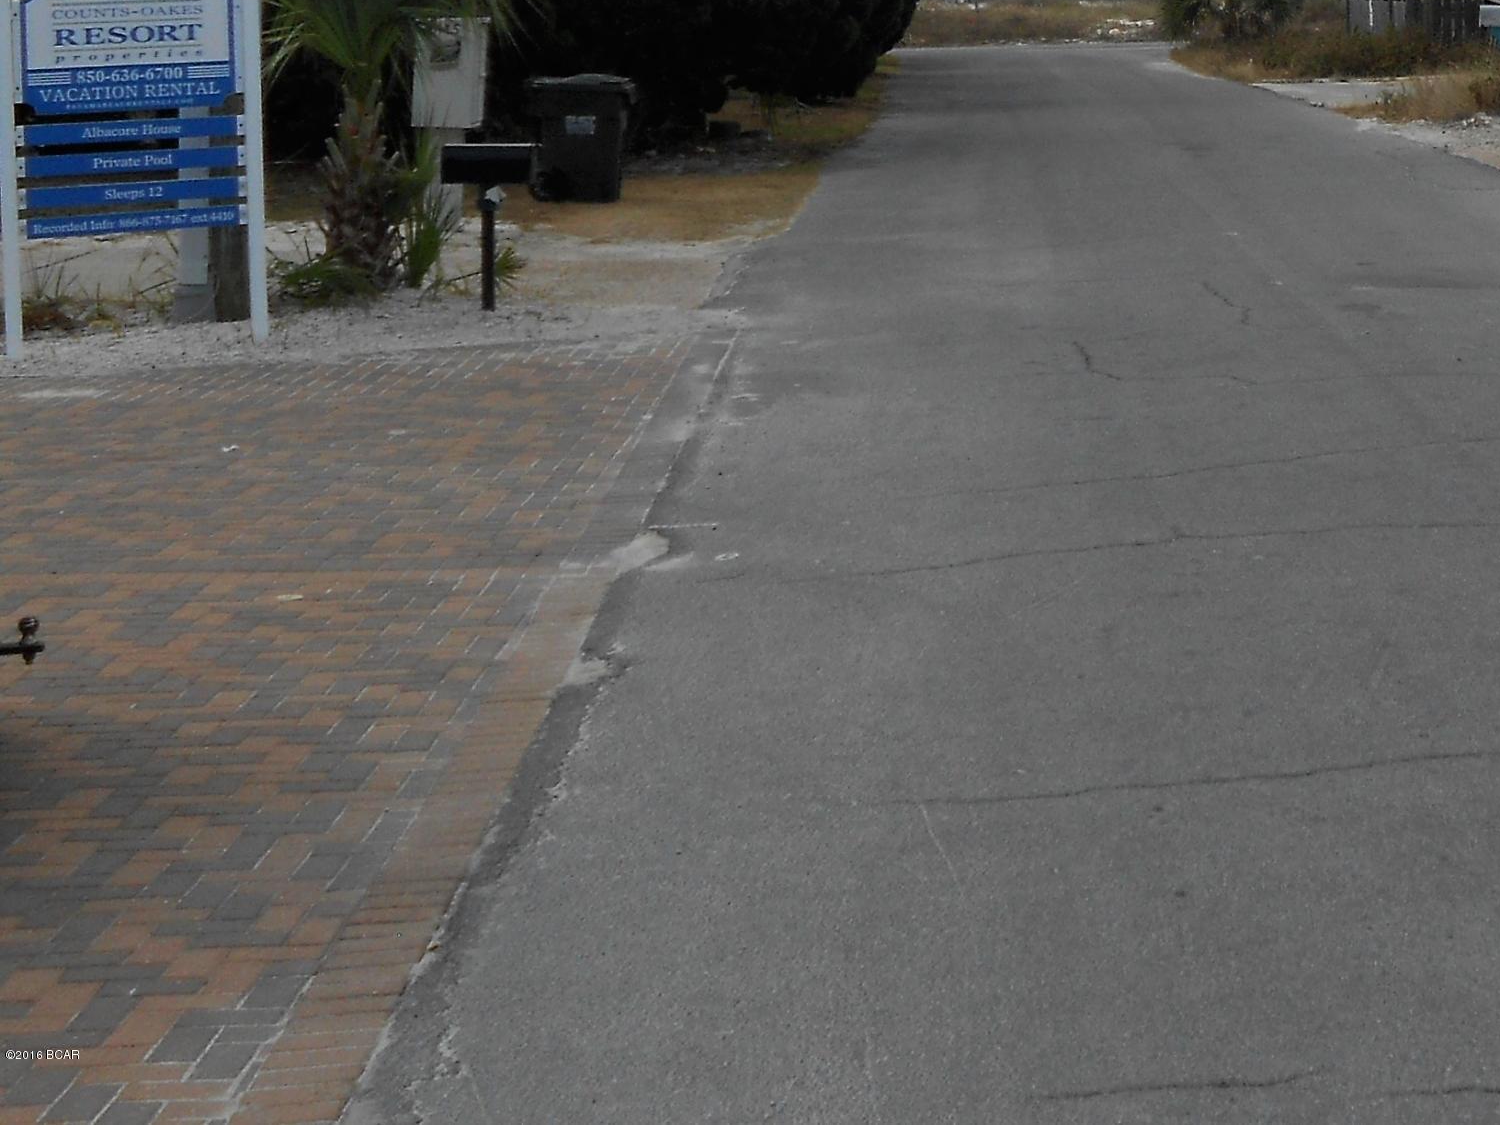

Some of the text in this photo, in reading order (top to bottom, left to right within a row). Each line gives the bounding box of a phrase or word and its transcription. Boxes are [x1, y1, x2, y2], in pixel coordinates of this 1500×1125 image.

[51, 4, 203, 20] COUNTS-OAKES
[53, 23, 203, 46] RESORT
[55, 48, 203, 64] properties
[76, 66, 182, 83] 850-636-6700
[40, 81, 220, 103] VACATION RENTAL
[82, 124, 181, 139] Albacore House
[93, 154, 173, 169] Private Pool
[104, 187, 163, 201] Sleeps 12
[33, 222, 88, 235] Recorded
